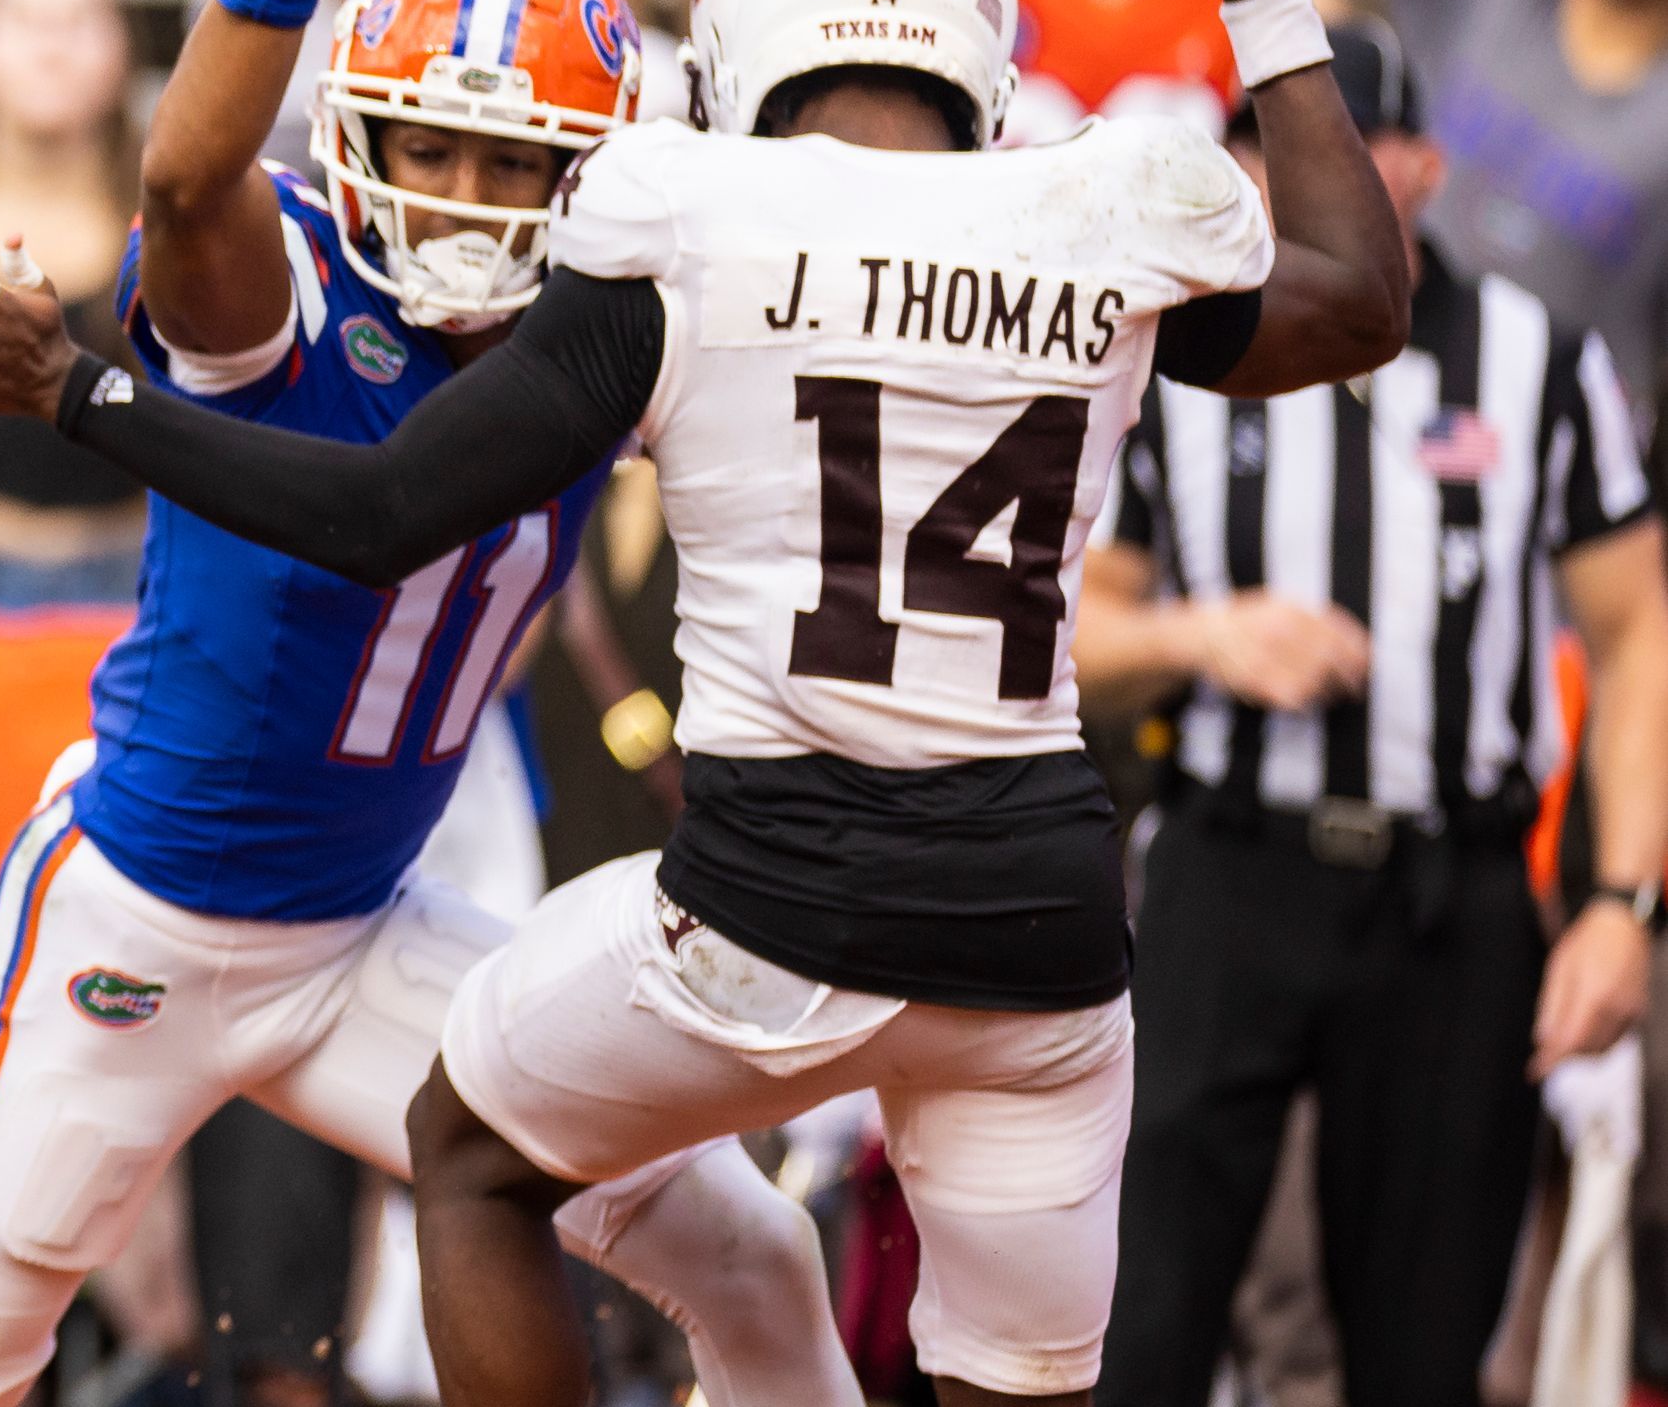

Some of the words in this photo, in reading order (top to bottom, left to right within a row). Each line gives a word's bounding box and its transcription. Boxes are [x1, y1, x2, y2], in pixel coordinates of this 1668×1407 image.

[819, 19, 890, 41] TEXAS
[764, 251, 821, 332] J.
[858, 257, 1125, 367] THOMAS
[325, 497, 562, 769] 11
[786, 374, 1091, 704] 14
